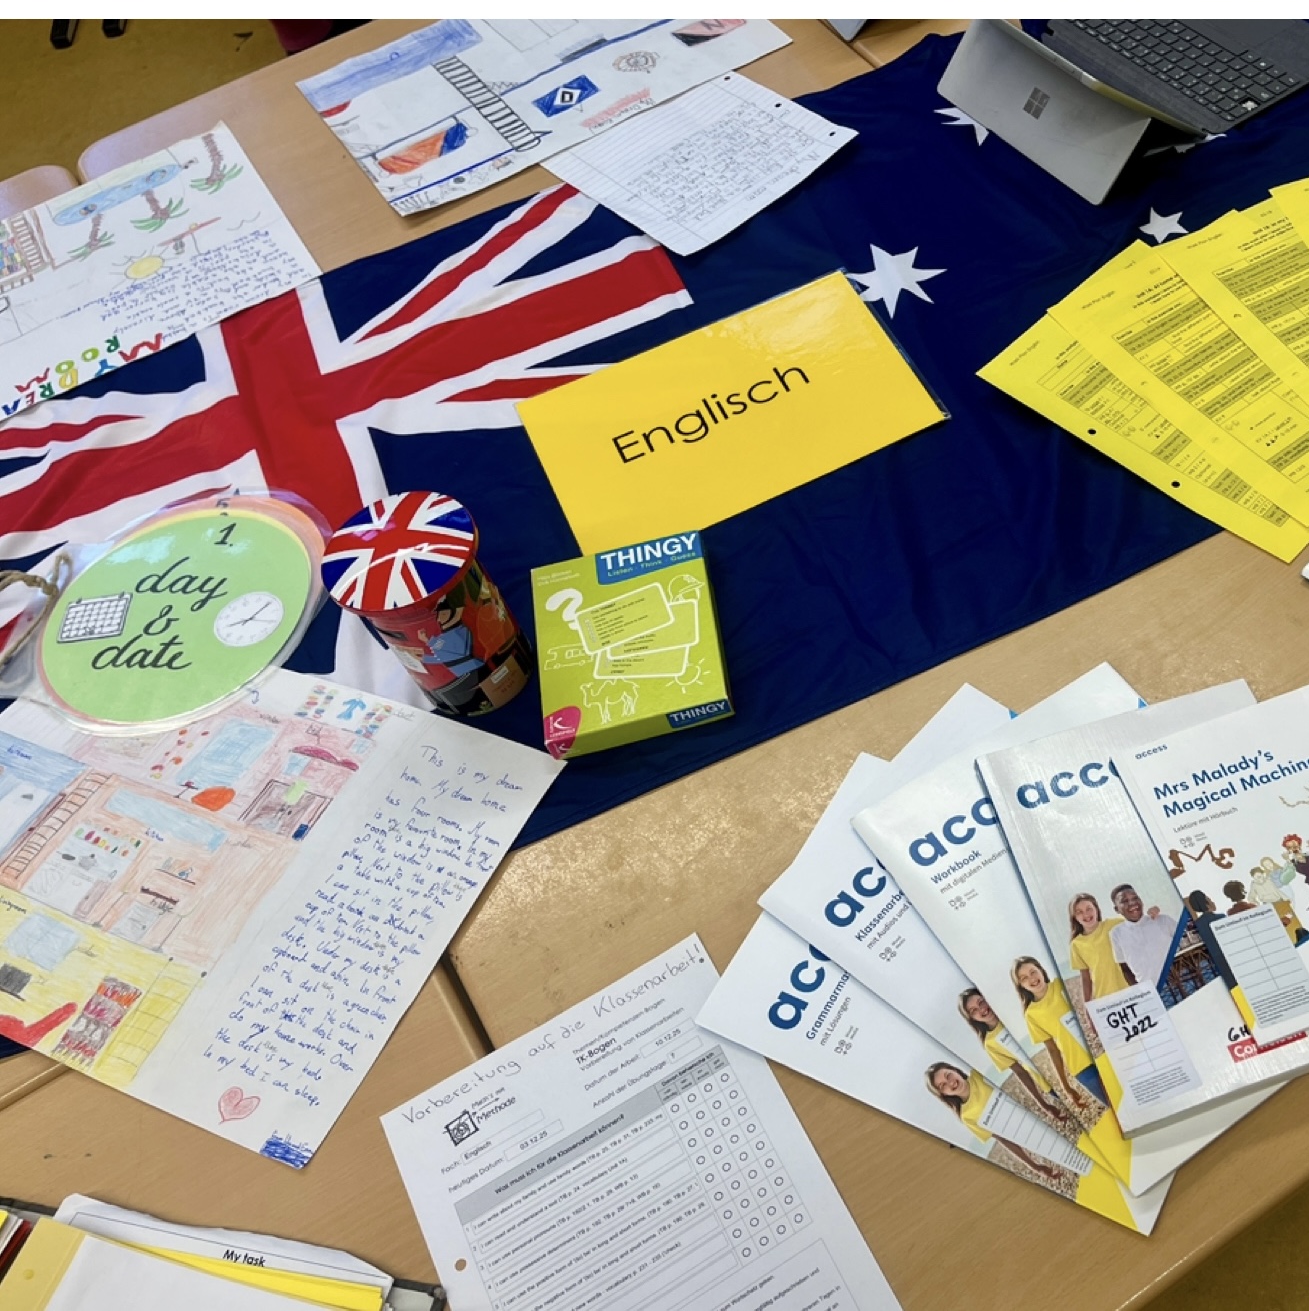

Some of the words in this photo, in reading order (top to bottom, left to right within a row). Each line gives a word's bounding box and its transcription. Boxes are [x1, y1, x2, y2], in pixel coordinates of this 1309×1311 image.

[612, 367, 810, 463] Englisch
[600, 534, 696, 570] THINGY
[135, 558, 229, 615] day
[608, 568, 633, 577] Listen
[143, 606, 172, 638] &
[91, 638, 194, 672] date
[669, 702, 726, 722] THINGY
[1135, 743, 1168, 760] access
[1153, 780, 1190, 800] Mrs
[1163, 786, 1238, 819] Magical
[931, 849, 982, 885] Workbook
[1106, 1002, 1138, 1028] GHT
[575, 1037, 617, 1065] TK-Bogen
[402, 1059, 522, 1124] Vorbereitung
[527, 1034, 555, 1058] auf
[561, 1019, 585, 1039] die
[223, 1249, 240, 1262] My
[242, 1253, 265, 1267] task
